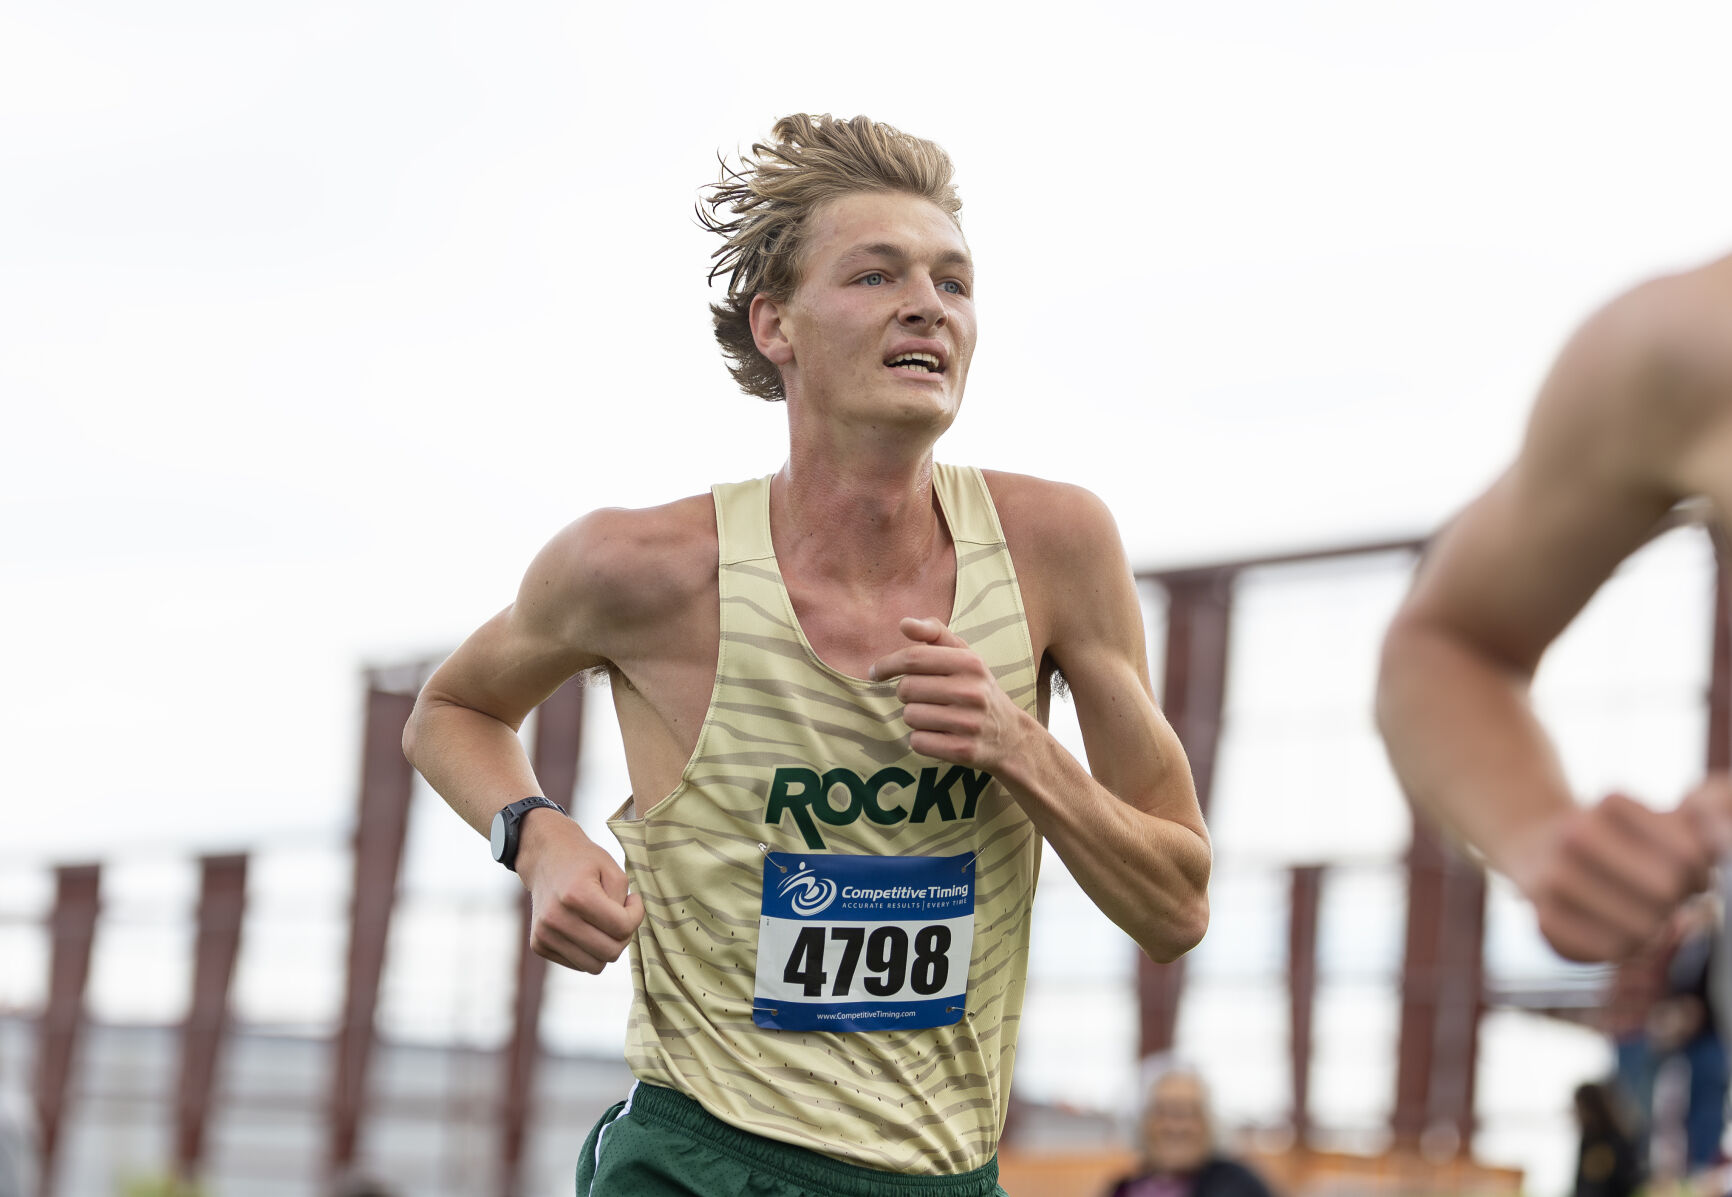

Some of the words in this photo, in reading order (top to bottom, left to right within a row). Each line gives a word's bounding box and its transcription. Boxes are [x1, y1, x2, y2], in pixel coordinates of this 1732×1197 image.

[765, 765, 993, 850] ROCKY
[926, 901, 950, 909] EVERY
[952, 897, 967, 906] TIME
[783, 924, 952, 997] 4798
[816, 1010, 916, 1021] www.CompetitiveTiming.com
